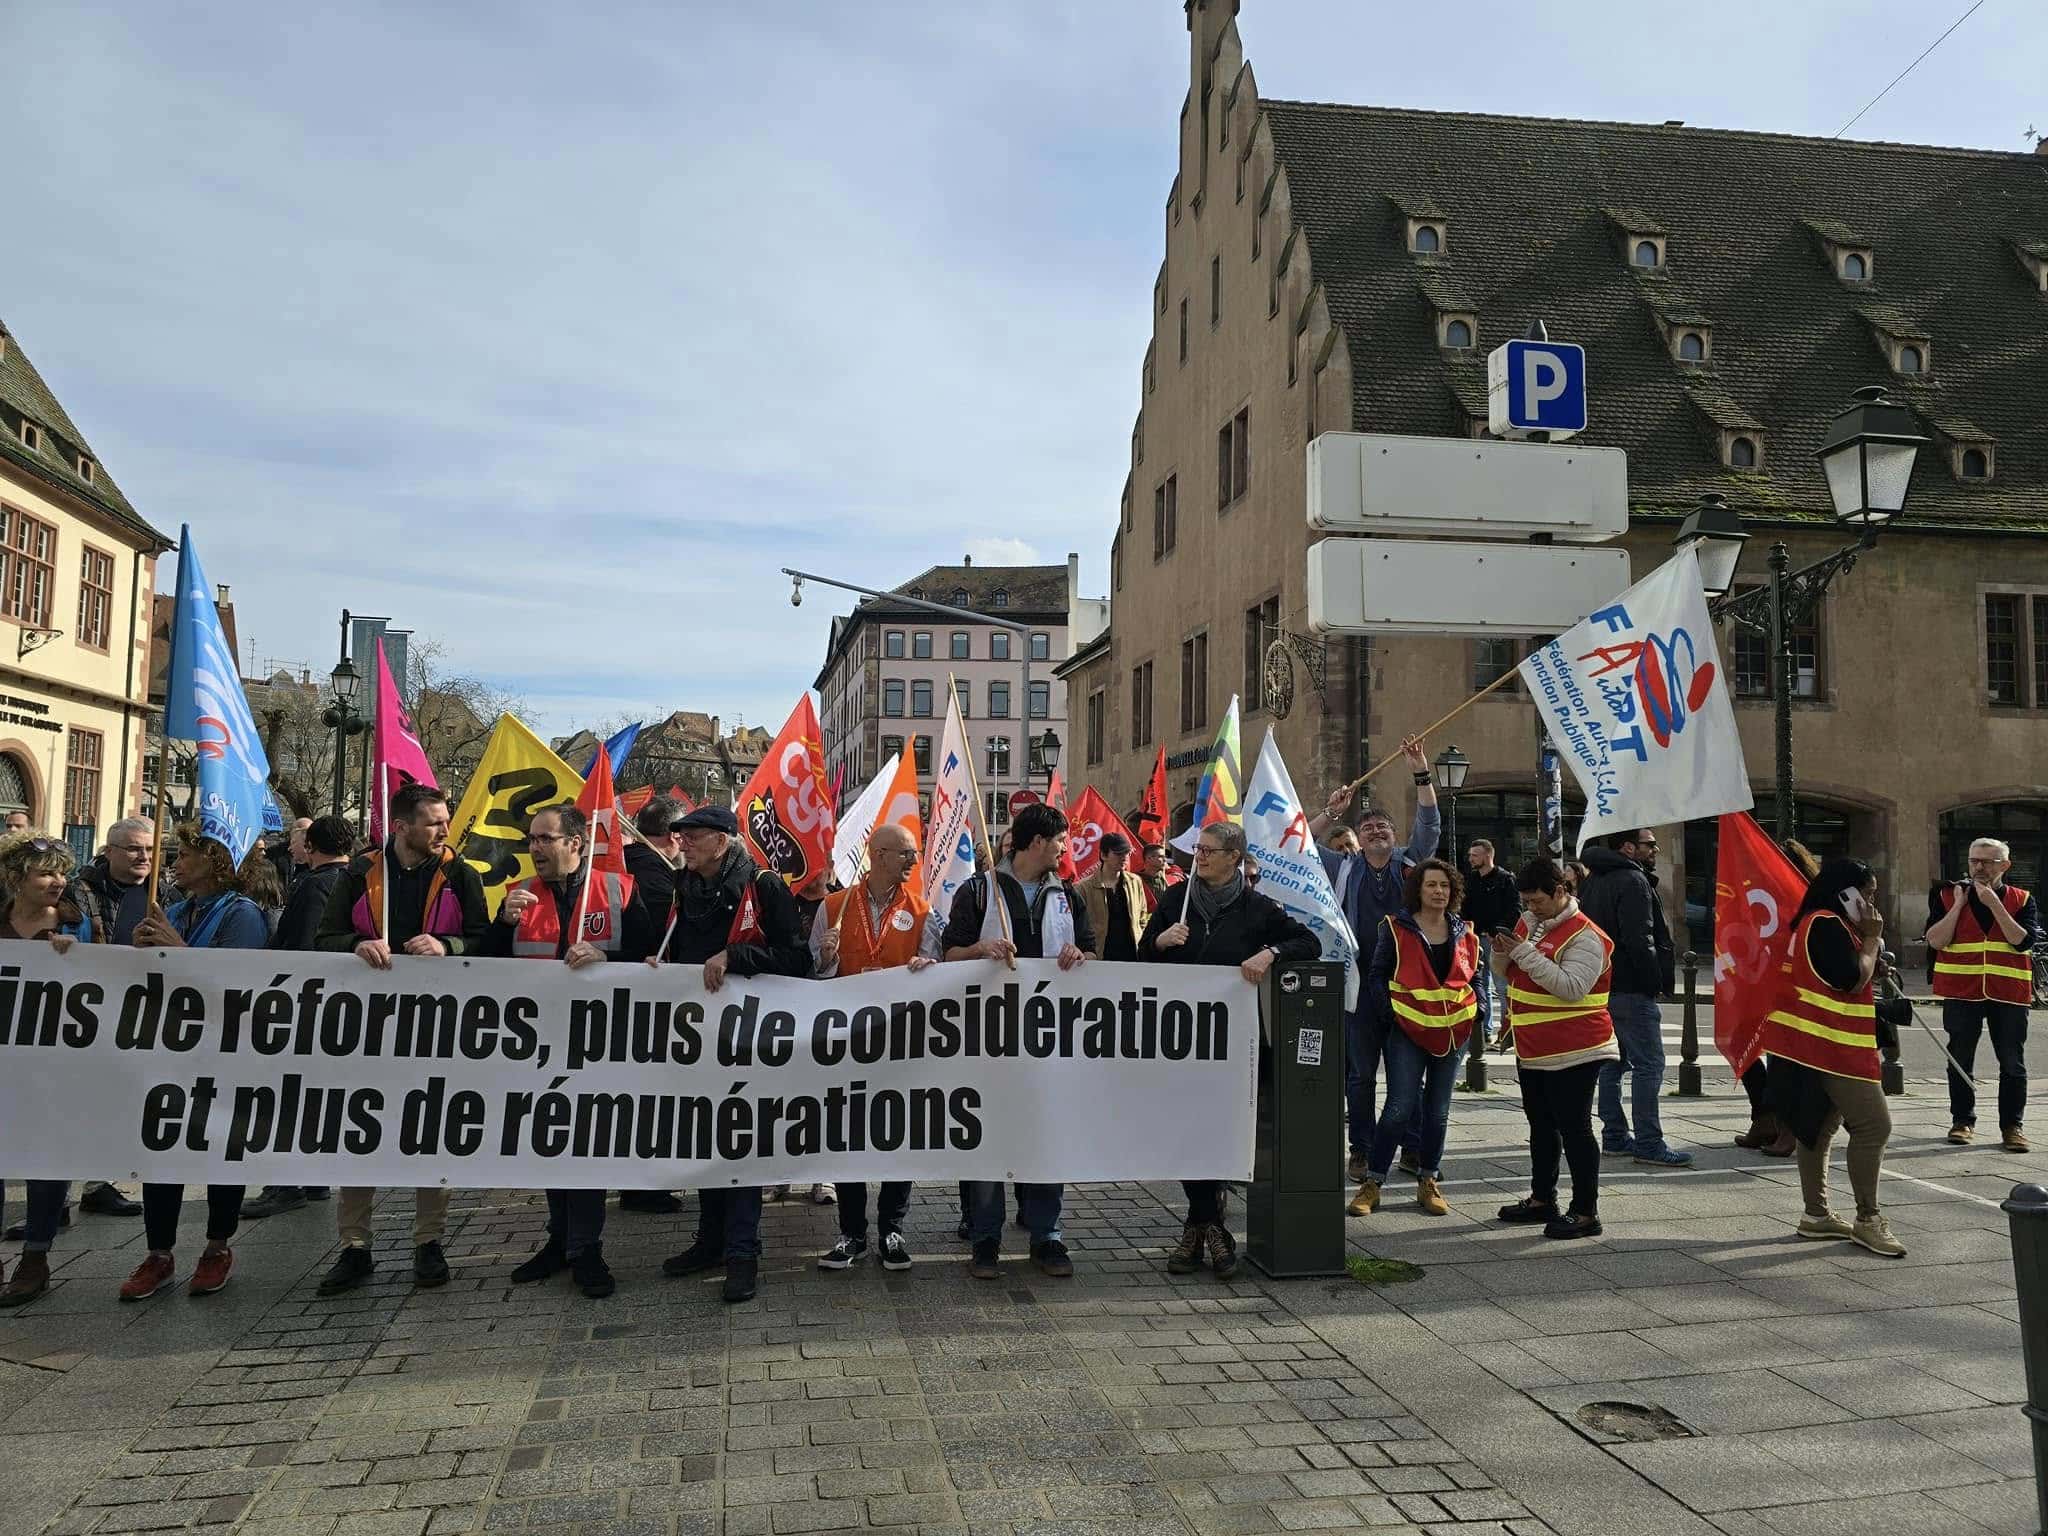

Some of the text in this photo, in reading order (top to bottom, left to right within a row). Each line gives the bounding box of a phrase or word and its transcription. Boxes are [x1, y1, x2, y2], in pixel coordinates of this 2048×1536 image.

[1524, 350, 1567, 421] P
[1530, 653, 1597, 768] onction Publique
[1546, 640, 1590, 717] Fédération
[1247, 843, 1323, 886] Fédération
[1258, 866, 1300, 890] nction
[0, 965, 1229, 1070] ins de réformes, plus de considération
[140, 1073, 983, 1162] et plus de rémunérations
